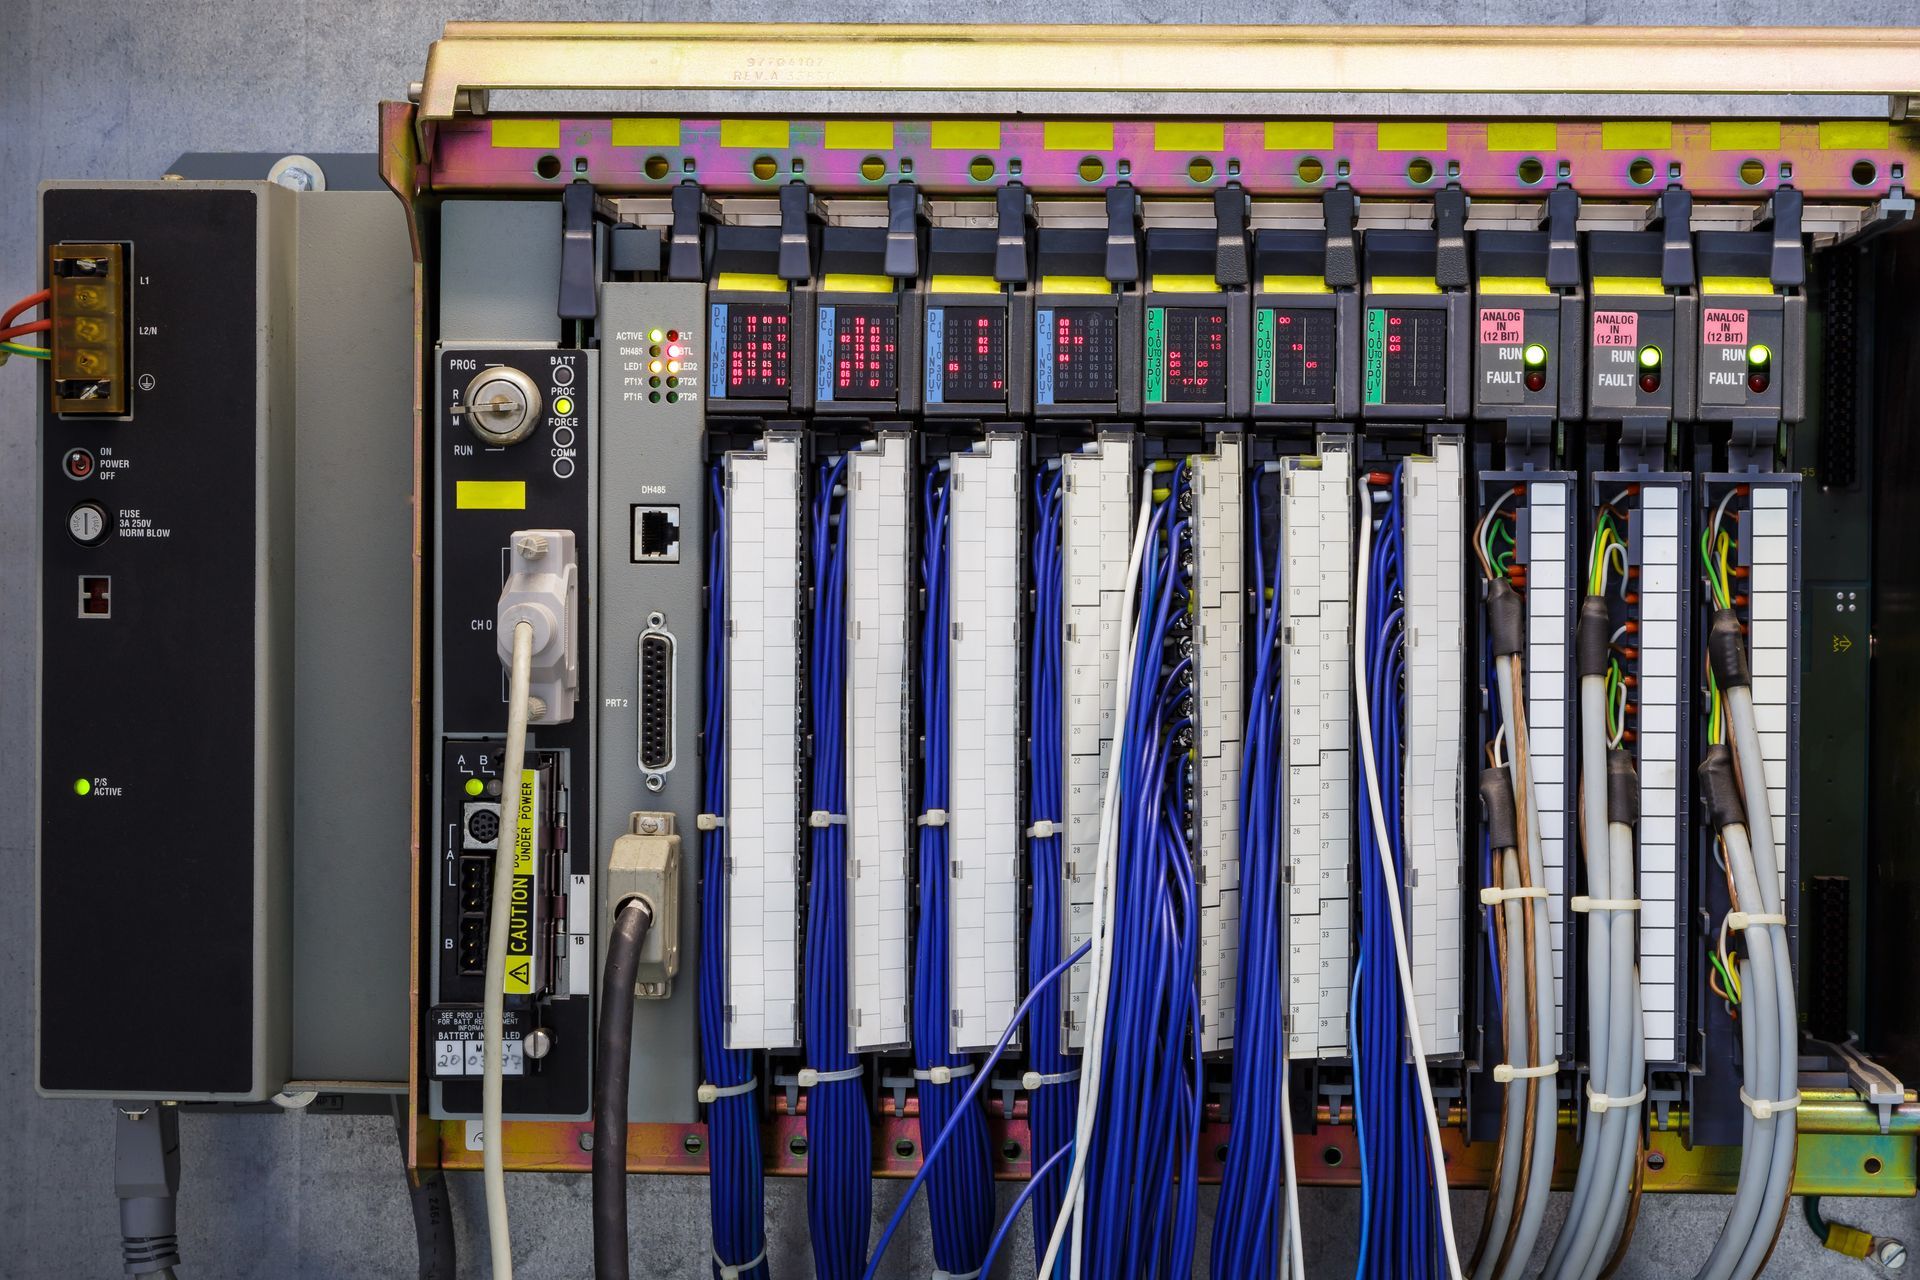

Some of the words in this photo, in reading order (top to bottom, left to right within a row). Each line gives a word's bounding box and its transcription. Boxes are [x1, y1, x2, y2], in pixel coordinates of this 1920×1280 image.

[140, 276, 149, 285] L1
[714, 307, 720, 328] DC
[747, 316, 756, 324] 10
[762, 316, 772, 324] 00
[776, 316, 786, 324] 10
[821, 310, 828, 330] DC
[1148, 310, 1154, 330] DC
[1258, 311, 1264, 332] DC
[1482, 312, 1520, 322] ANALOG
[1596, 315, 1634, 325] ANALOG
[1706, 313, 1744, 323] ANALOG
[930, 312, 936, 332] DC
[1040, 314, 1045, 334] DC
[1369, 312, 1376, 332] DC
[1496, 322, 1506, 330] IN
[139, 326, 158, 336] L2/N
[1610, 325, 1620, 334] IN
[1721, 323, 1730, 332] IN
[616, 332, 643, 340] ACTIVE
[678, 332, 692, 340] FLT
[776, 334, 786, 342] 12
[1483, 331, 1498, 342] (12
[1499, 331, 1520, 342] BIT)
[1596, 334, 1612, 344] (12
[1613, 334, 1632, 344] BIT)
[1708, 332, 1722, 343] (12
[1724, 332, 1744, 343] BIT)
[620, 347, 643, 355] DH485
[1499, 348, 1522, 360] RUN
[1722, 348, 1746, 361] RUN
[550, 356, 576, 365] BATT
[1611, 350, 1634, 362] RUN
[450, 360, 476, 370] PROG
[624, 362, 642, 370] LED1
[678, 362, 698, 370] LED2
[732, 360, 742, 368] 05
[747, 360, 756, 368] 15
[762, 360, 772, 368] 05
[1256, 338, 1264, 400] OUTPUT
[624, 378, 643, 386] PT1X
[678, 378, 697, 386] PT2X
[1486, 372, 1522, 384] FAULT
[1598, 374, 1634, 386] FAULT
[1710, 373, 1745, 384] FAULT
[551, 387, 576, 396] PROC
[678, 392, 698, 400] PT2R
[548, 418, 578, 427] FORCE
[100, 448, 112, 456] ON
[454, 445, 473, 456] RUN
[550, 448, 576, 457] COMM
[100, 460, 130, 468] POWER
[100, 472, 116, 480] OFF
[642, 486, 666, 494] DH485
[120, 510, 140, 518] FUSE
[120, 520, 130, 528] 3A
[132, 520, 152, 528] 250V
[120, 529, 144, 537] NORM
[146, 529, 170, 538] BLOW
[471, 620, 484, 630] CH
[606, 698, 622, 708] PRT
[622, 698, 628, 708] 2
[457, 754, 466, 765] A
[480, 755, 488, 765] B
[1322, 752, 1329, 760] 21
[94, 778, 108, 786] P/S
[94, 788, 122, 796] ACTIVE
[521, 782, 532, 820] POWER
[520, 828, 531, 862] UNDER
[446, 850, 454, 860] A
[574, 876, 585, 885] 1A
[510, 877, 528, 952] CAUTION
[444, 938, 454, 950] B
[574, 936, 584, 945] 1B
[438, 1032, 474, 1040] BATTERY
[446, 1044, 452, 1053] D
[476, 1044, 482, 1052] M
[506, 1044, 512, 1052] Y
